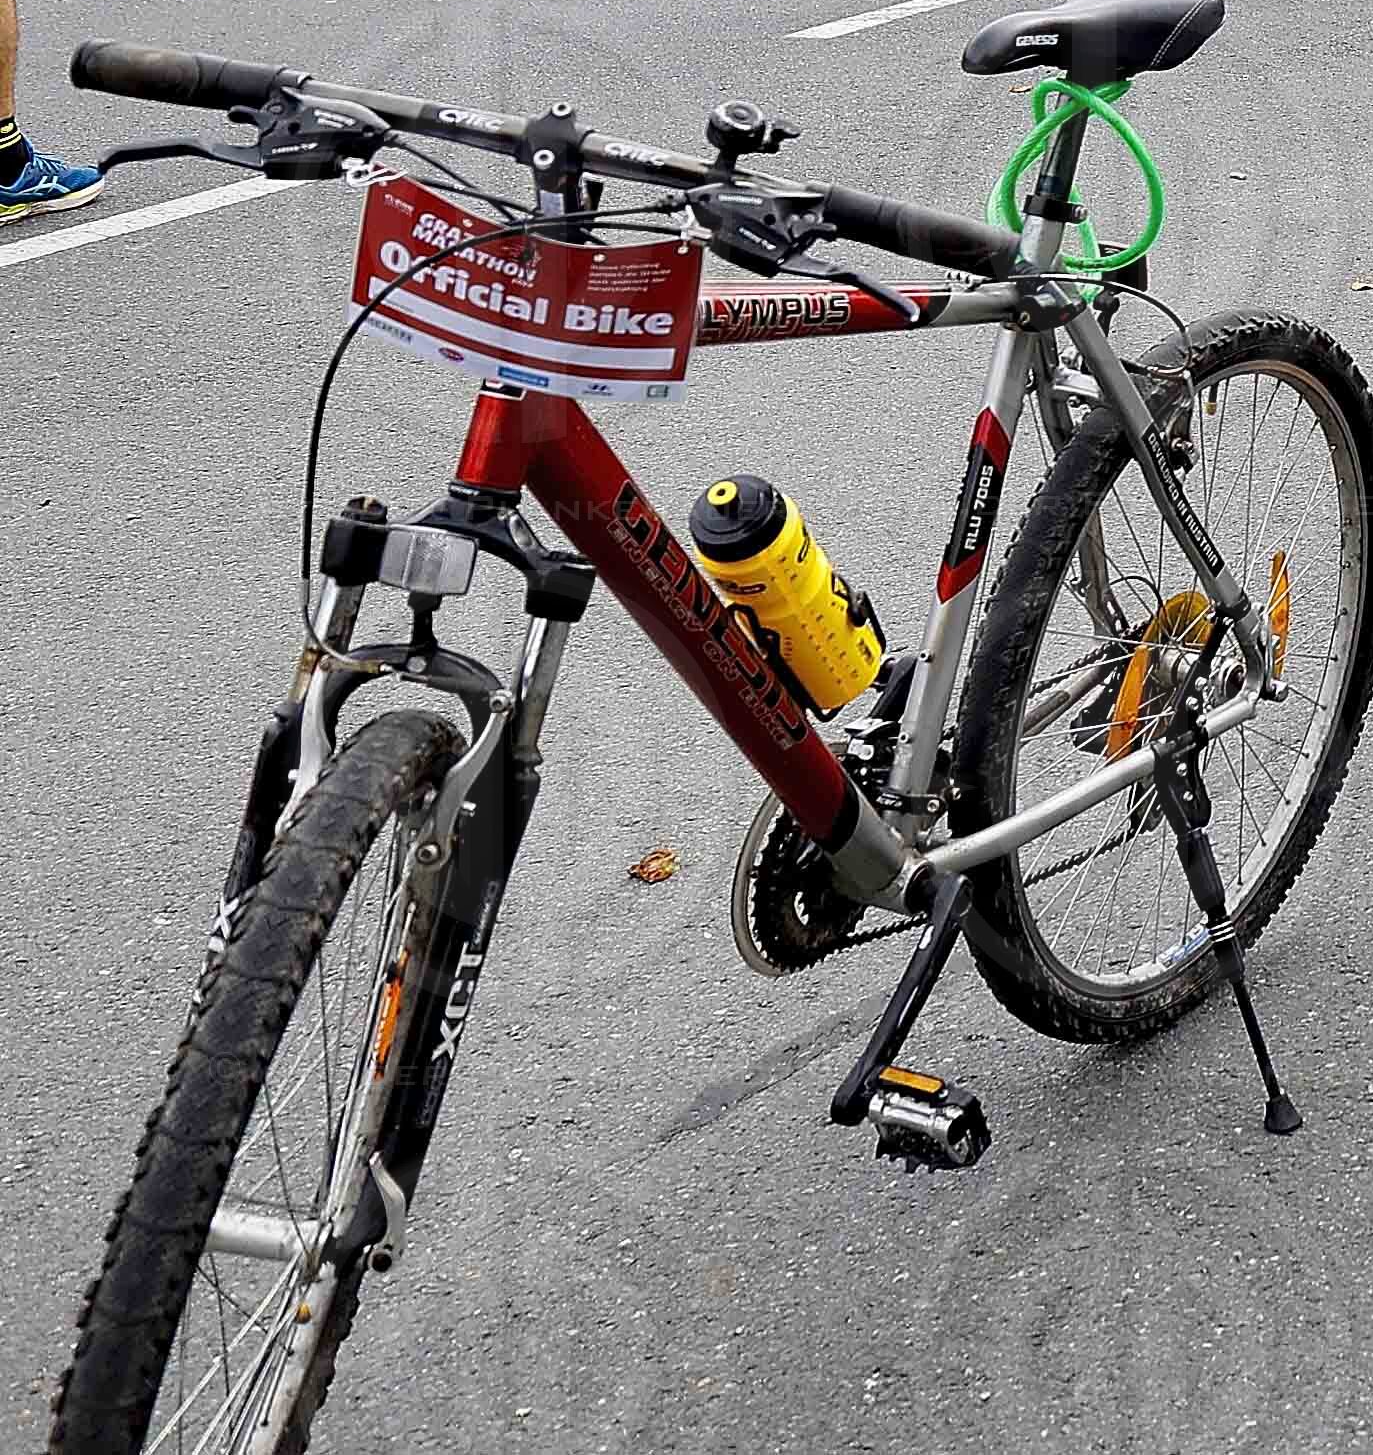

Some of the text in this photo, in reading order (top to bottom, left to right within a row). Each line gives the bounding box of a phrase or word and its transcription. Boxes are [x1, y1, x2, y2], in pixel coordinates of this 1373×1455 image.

[1015, 34, 1060, 46] GENESIS
[563, 303, 676, 336] Bike
[698, 290, 850, 328] LYMPUS
[1148, 432, 1219, 568] DEVELOPED IN AUSTRIA
[430, 941, 484, 1062] XCT
